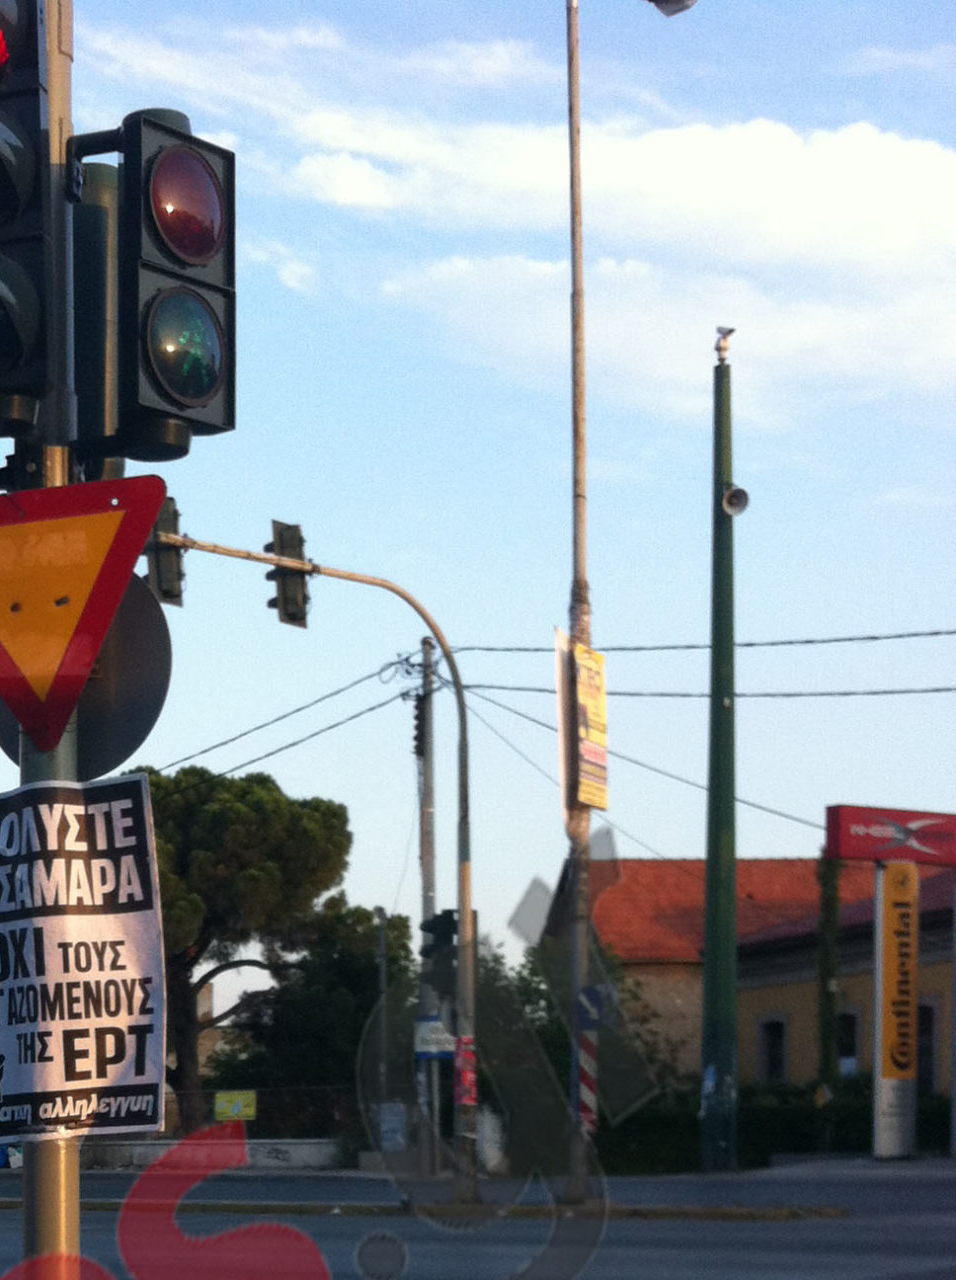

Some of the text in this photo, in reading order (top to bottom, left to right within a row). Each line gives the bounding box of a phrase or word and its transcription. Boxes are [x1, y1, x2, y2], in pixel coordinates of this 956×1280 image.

[57, 940, 126, 974] ΤΟΥΣ
[890, 901, 912, 1070] Continental
[17, 1023, 154, 1082] ΤΗΣ ΕΡΤ
[39, 1093, 155, 1120] αλληλεγγυη
